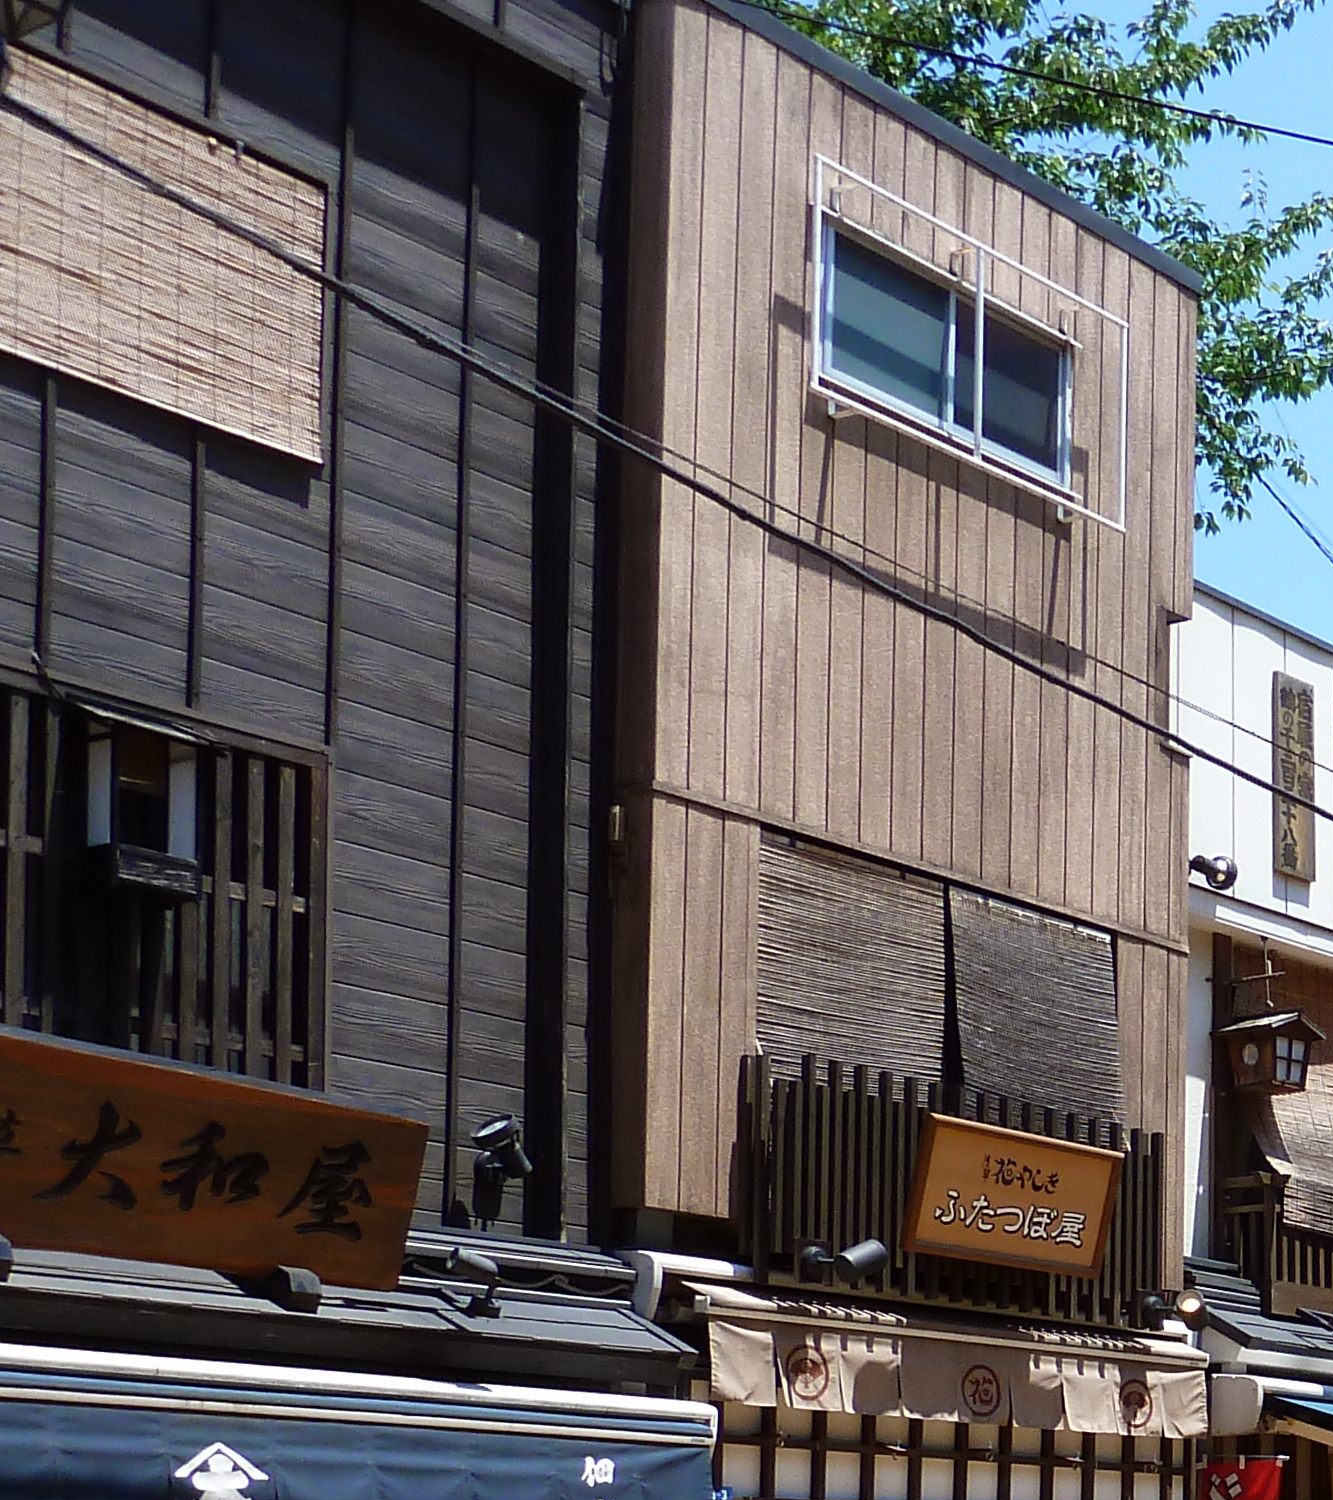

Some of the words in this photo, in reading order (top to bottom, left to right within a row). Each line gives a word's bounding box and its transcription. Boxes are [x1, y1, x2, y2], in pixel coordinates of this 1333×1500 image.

[33, 1100, 373, 1242] 大和屋
[933, 1189, 1087, 1248] ふたつぼ屋
